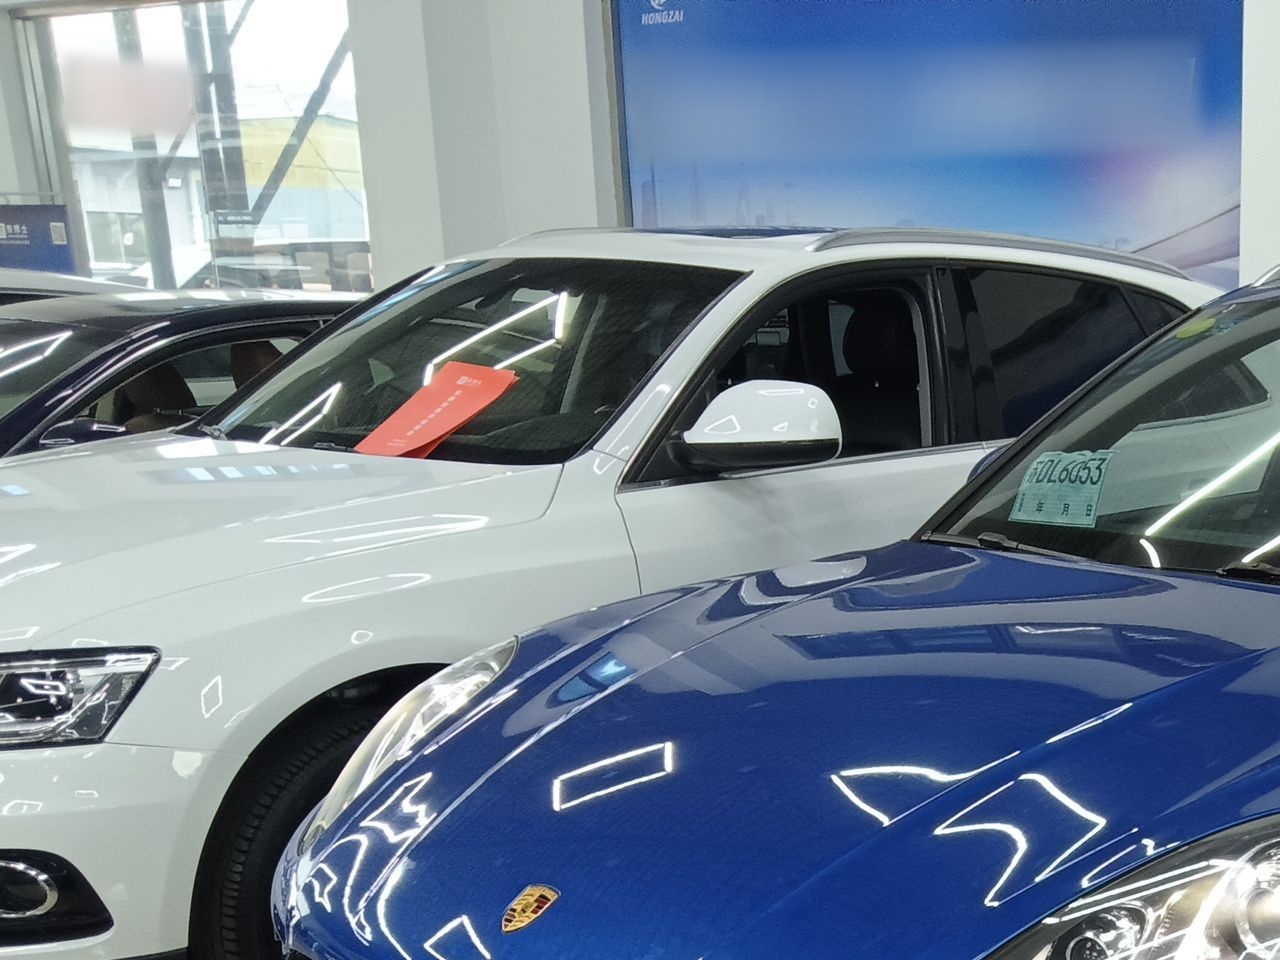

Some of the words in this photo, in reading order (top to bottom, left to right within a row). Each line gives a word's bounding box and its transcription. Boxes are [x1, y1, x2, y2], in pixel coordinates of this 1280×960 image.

[641, 9, 684, 25] HONGZAI
[1060, 503, 1071, 516] 月
[1085, 504, 1094, 517] 日
